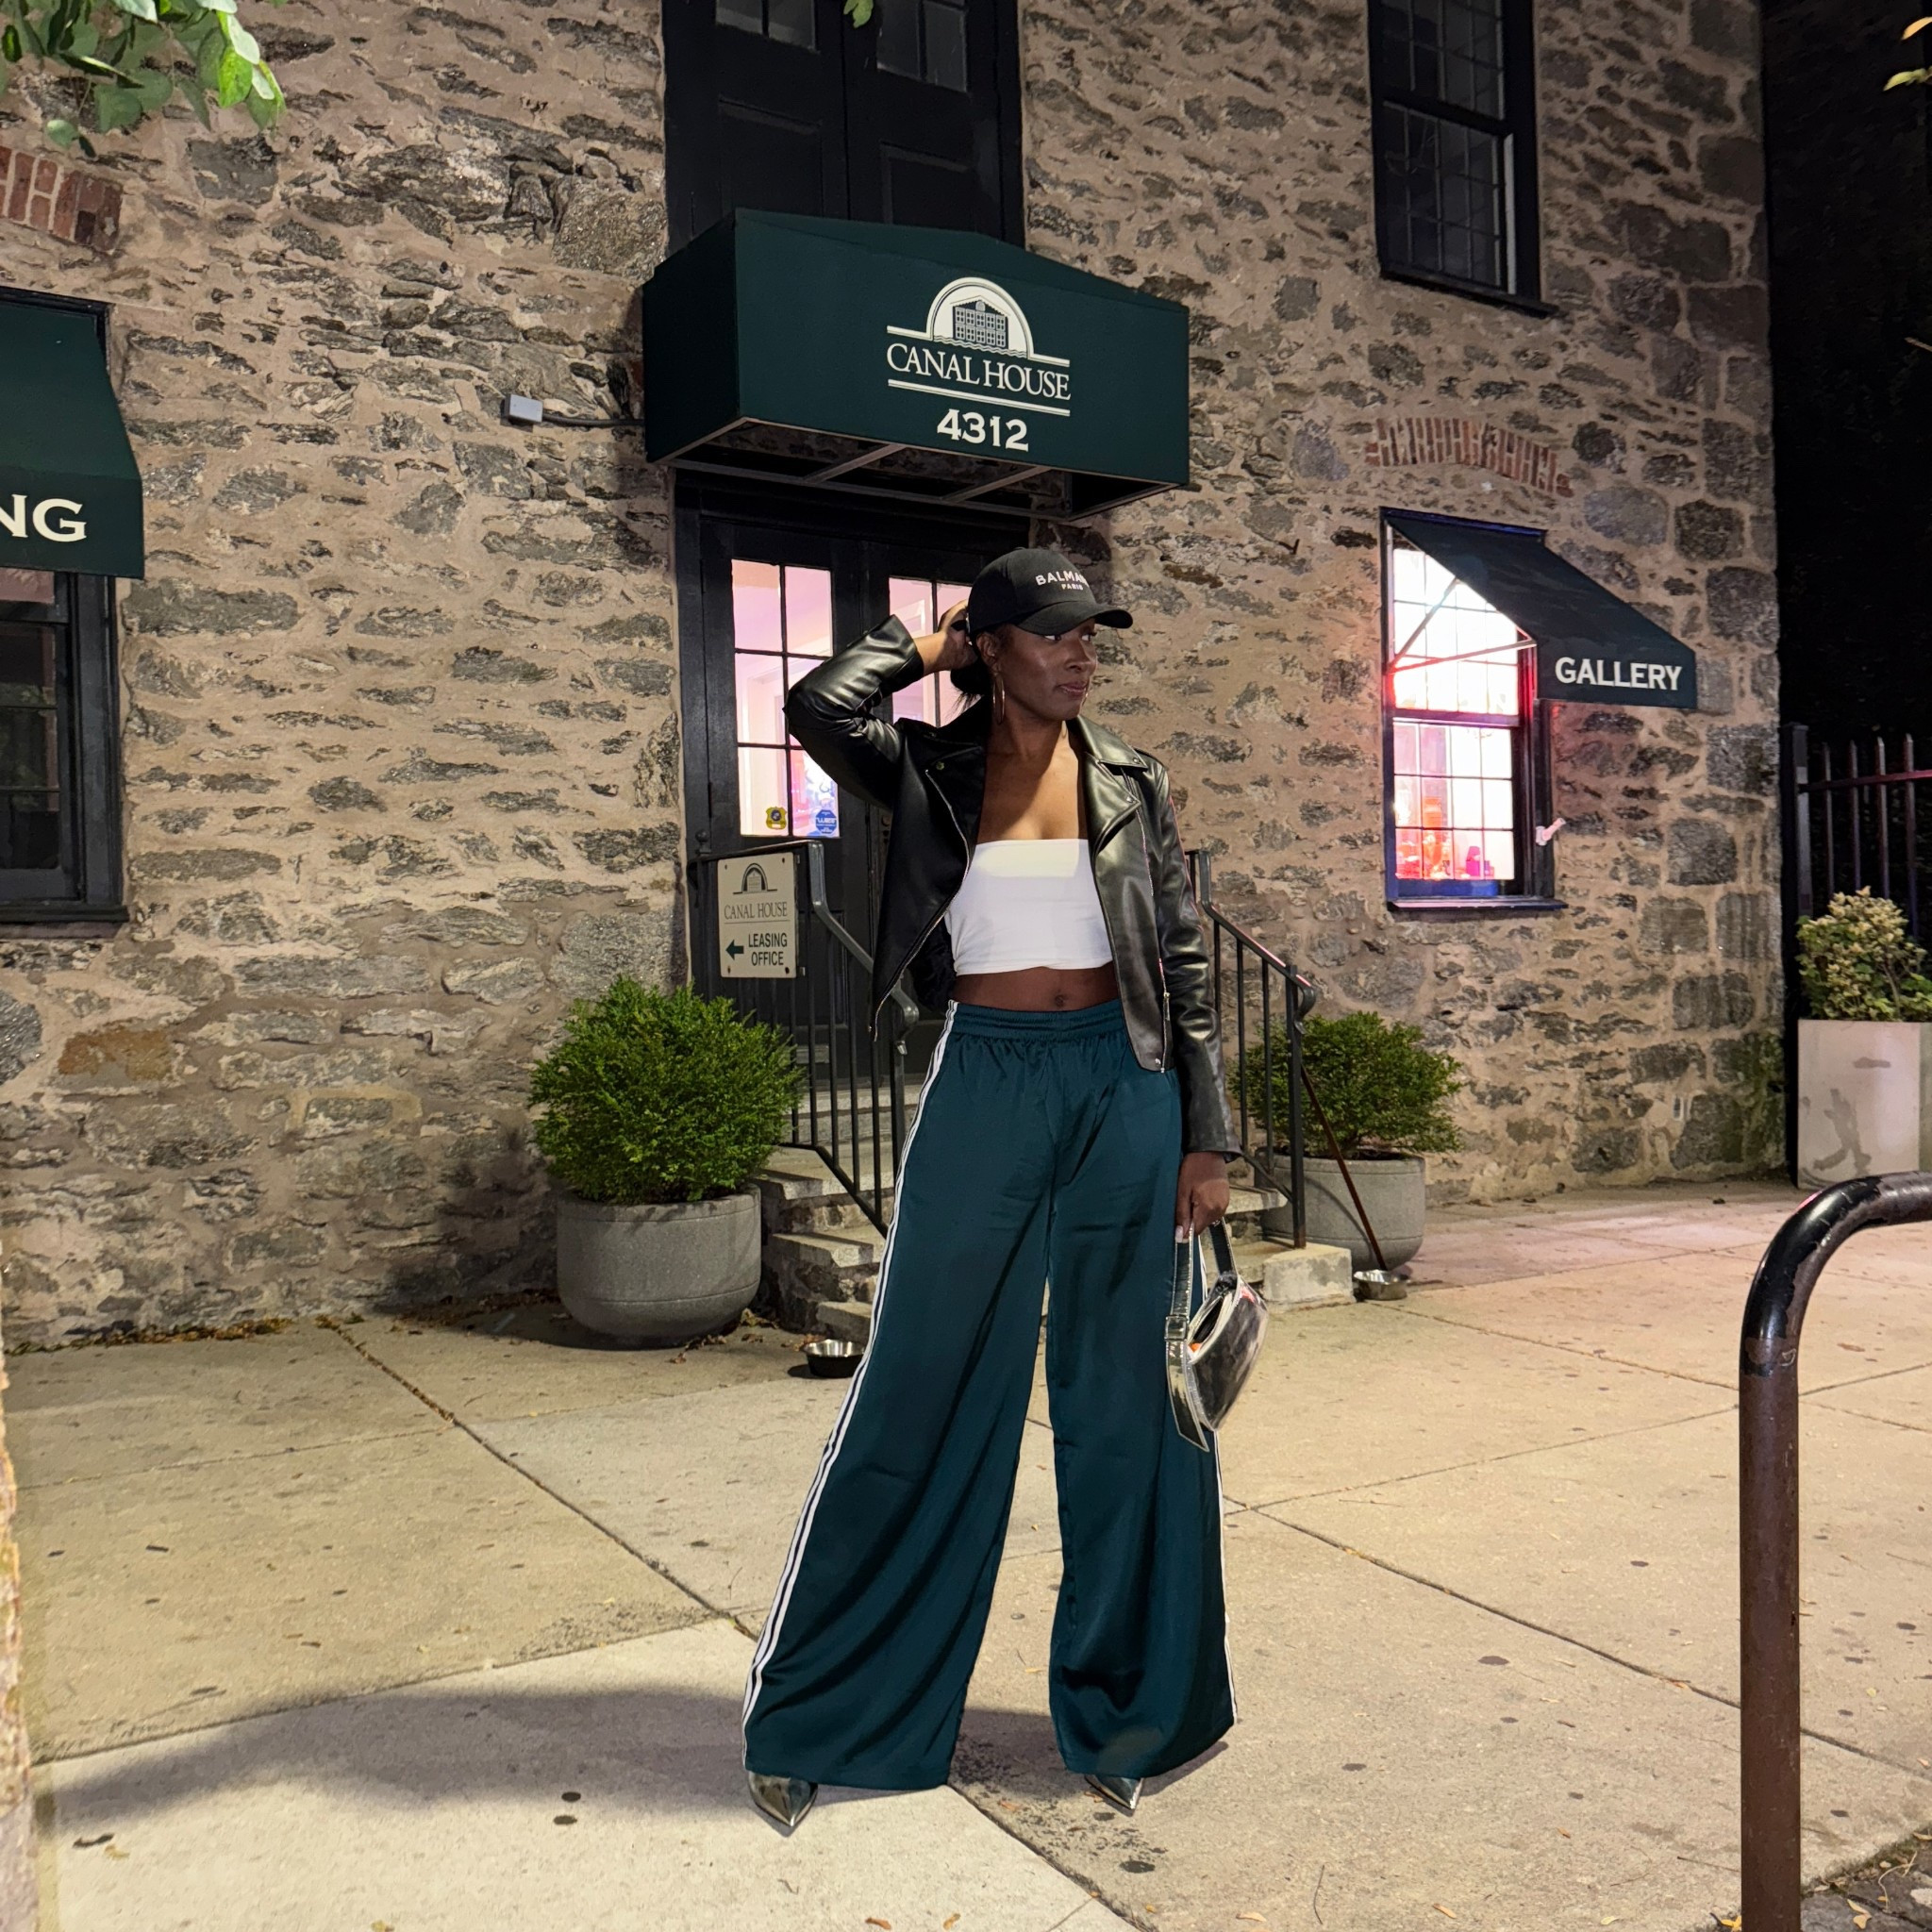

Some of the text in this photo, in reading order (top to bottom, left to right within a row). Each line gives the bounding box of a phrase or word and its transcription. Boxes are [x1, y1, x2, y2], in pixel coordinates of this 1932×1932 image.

[887, 342, 1072, 401] CANAL HOUSE
[937, 408, 1028, 452] 4312
[1555, 657, 1683, 691] GALLERY
[724, 901, 788, 920] CANAL HOUSE
[748, 932, 788, 948] LEASING
[751, 951, 784, 966] OFFICE
